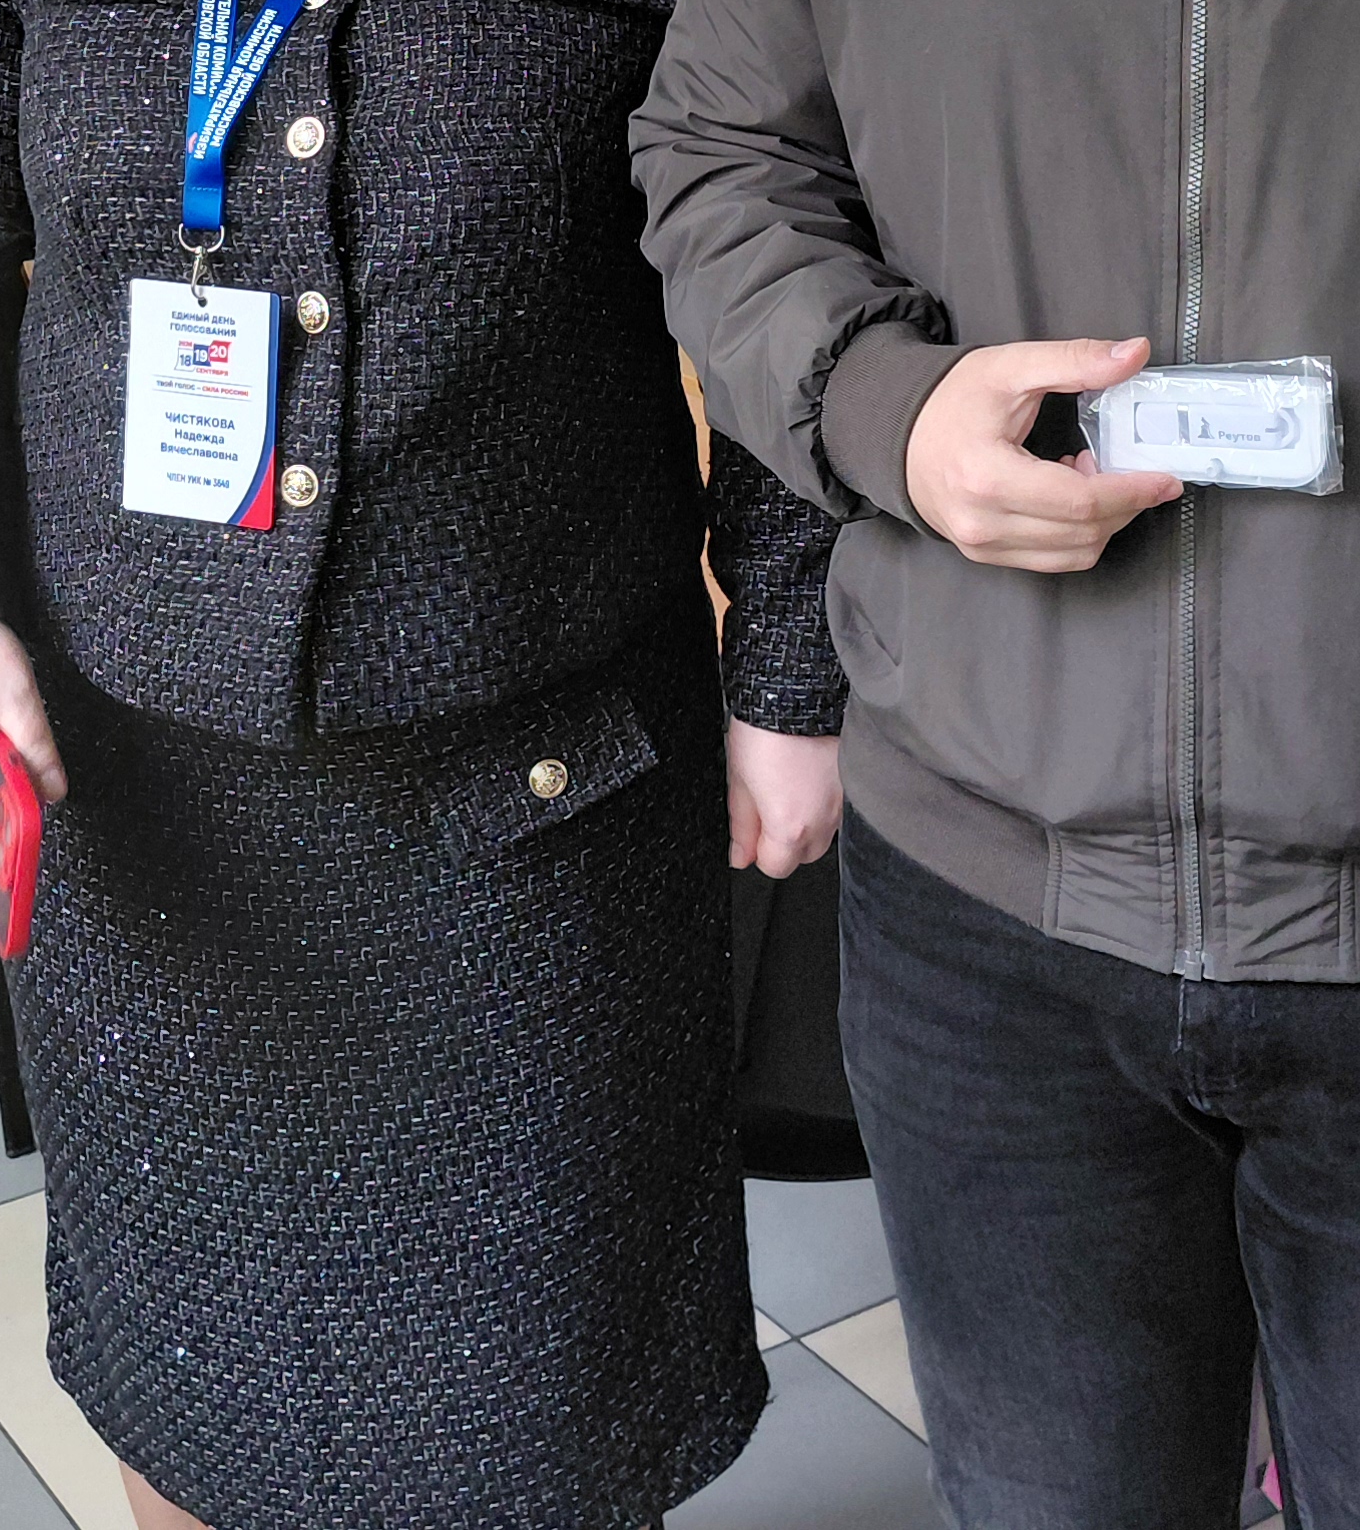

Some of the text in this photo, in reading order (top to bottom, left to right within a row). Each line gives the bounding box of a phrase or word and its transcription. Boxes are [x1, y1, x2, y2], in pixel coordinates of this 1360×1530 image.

[192, 42, 210, 95] ОБЛАСТИ
[193, 8, 278, 160] ИЗБИРАТЕЛЬНАЯ КОМИССИЯ
[210, 24, 284, 148] МОСКОВСКОЙ ОБЛАСТИ
[171, 311, 236, 325] ЕДИНЫЙ ДЕНЬ
[170, 322, 237, 337] ГОЛОСОВАНИЯ
[180, 345, 227, 367] 18 19 20
[196, 367, 228, 376] СЕНТЯБРЯ
[156, 380, 173, 388] ТВОЙ
[174, 382, 195, 390] ГОЛОС
[202, 385, 219, 393] СИЛА
[165, 411, 235, 430] ЧИСТЯКОВА
[175, 428, 224, 445] Надежда
[1218, 430, 1261, 443] Реутов
[160, 442, 238, 461] Вячеславовна
[166, 472, 186, 483] ЧЛЕН
[188, 475, 201, 485] УИК
